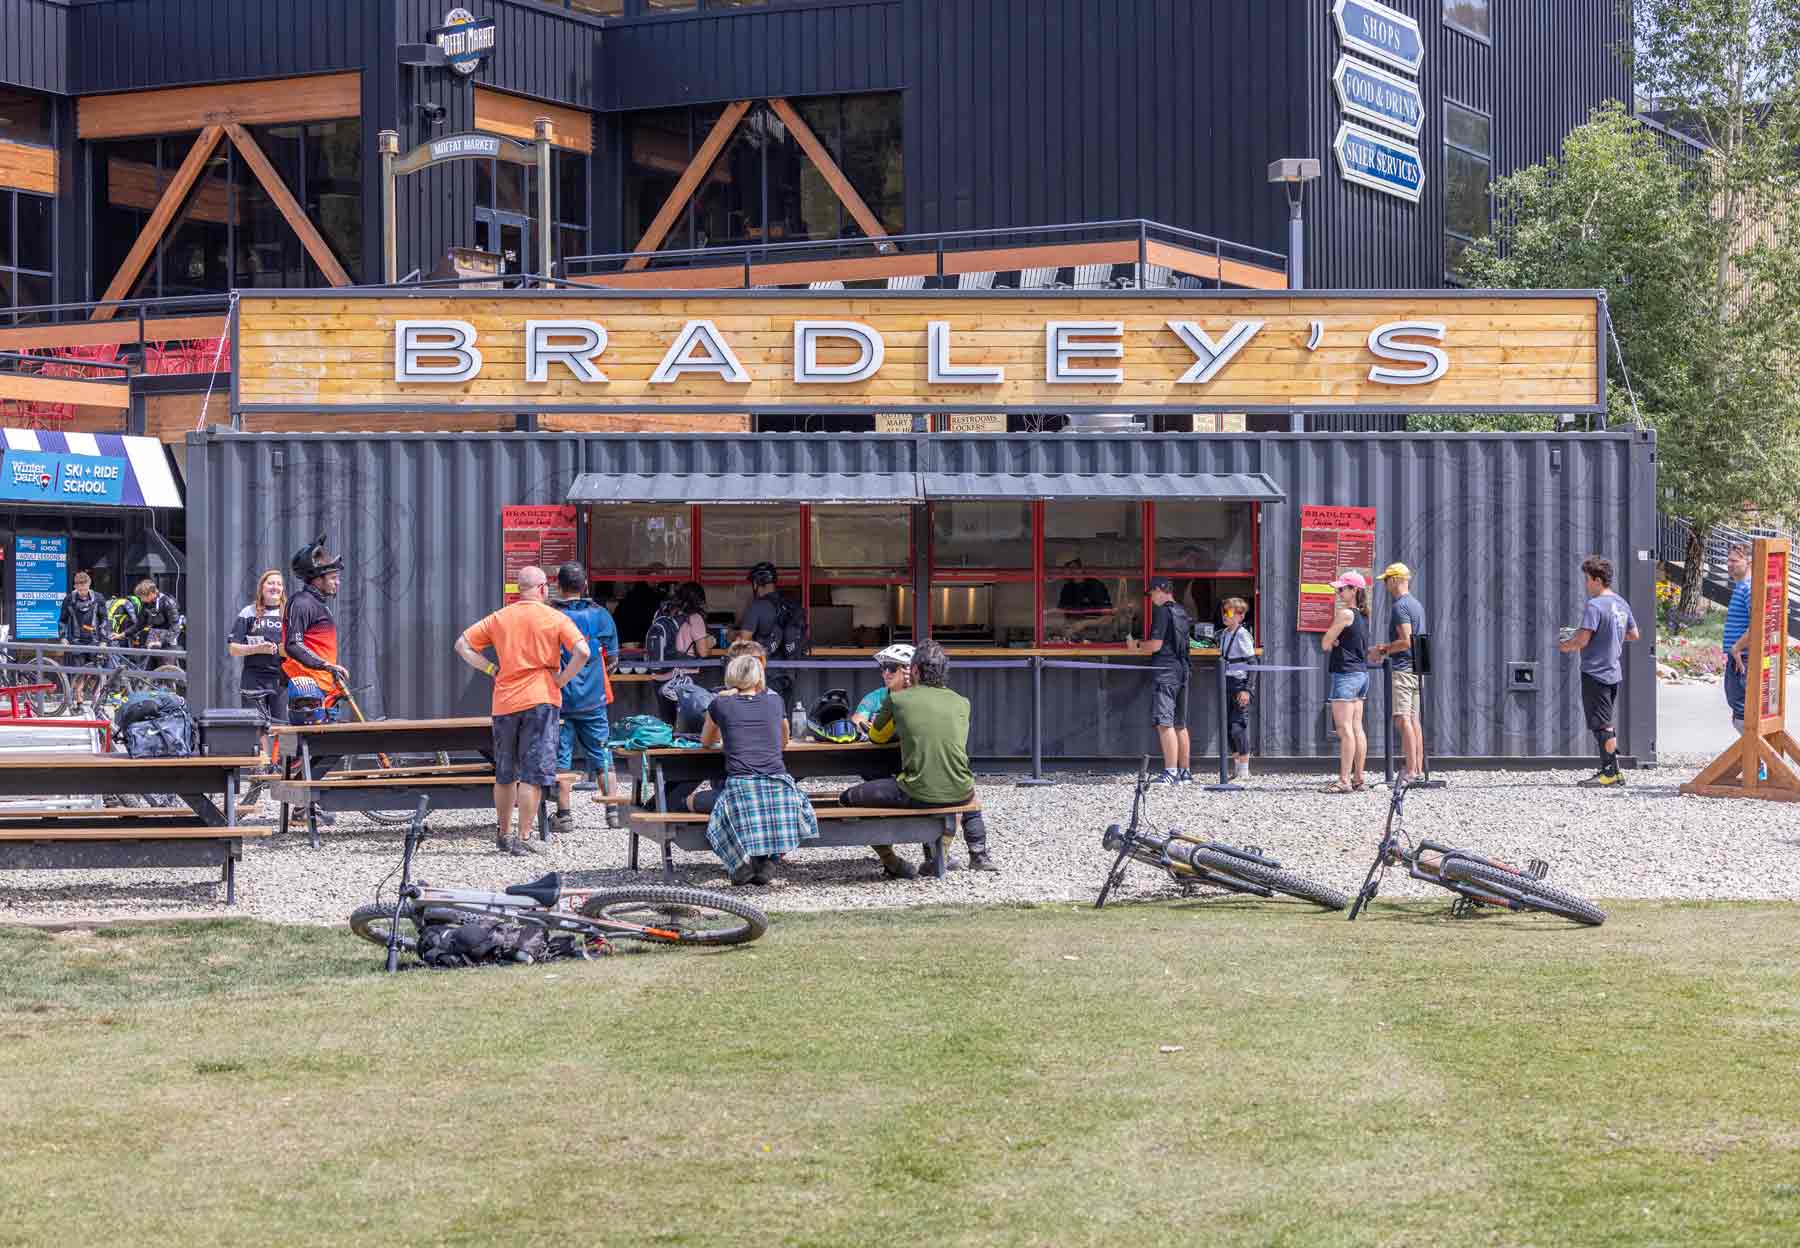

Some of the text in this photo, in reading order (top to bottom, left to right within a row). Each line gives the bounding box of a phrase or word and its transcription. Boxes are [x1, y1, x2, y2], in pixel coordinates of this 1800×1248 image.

[1362, 14, 1400, 50] SHOPS
[1346, 73, 1417, 121] FOOD & DRINK
[434, 137, 494, 154] MOFFAT MARKET
[1346, 142, 1418, 185] SKIER SERVICES
[394, 320, 1449, 385] BRADLEY'S
[11, 460, 46, 474] Winter
[65, 463, 83, 477] SKI
[94, 465, 119, 479] RIDE
[63, 480, 107, 494] SCHOOL
